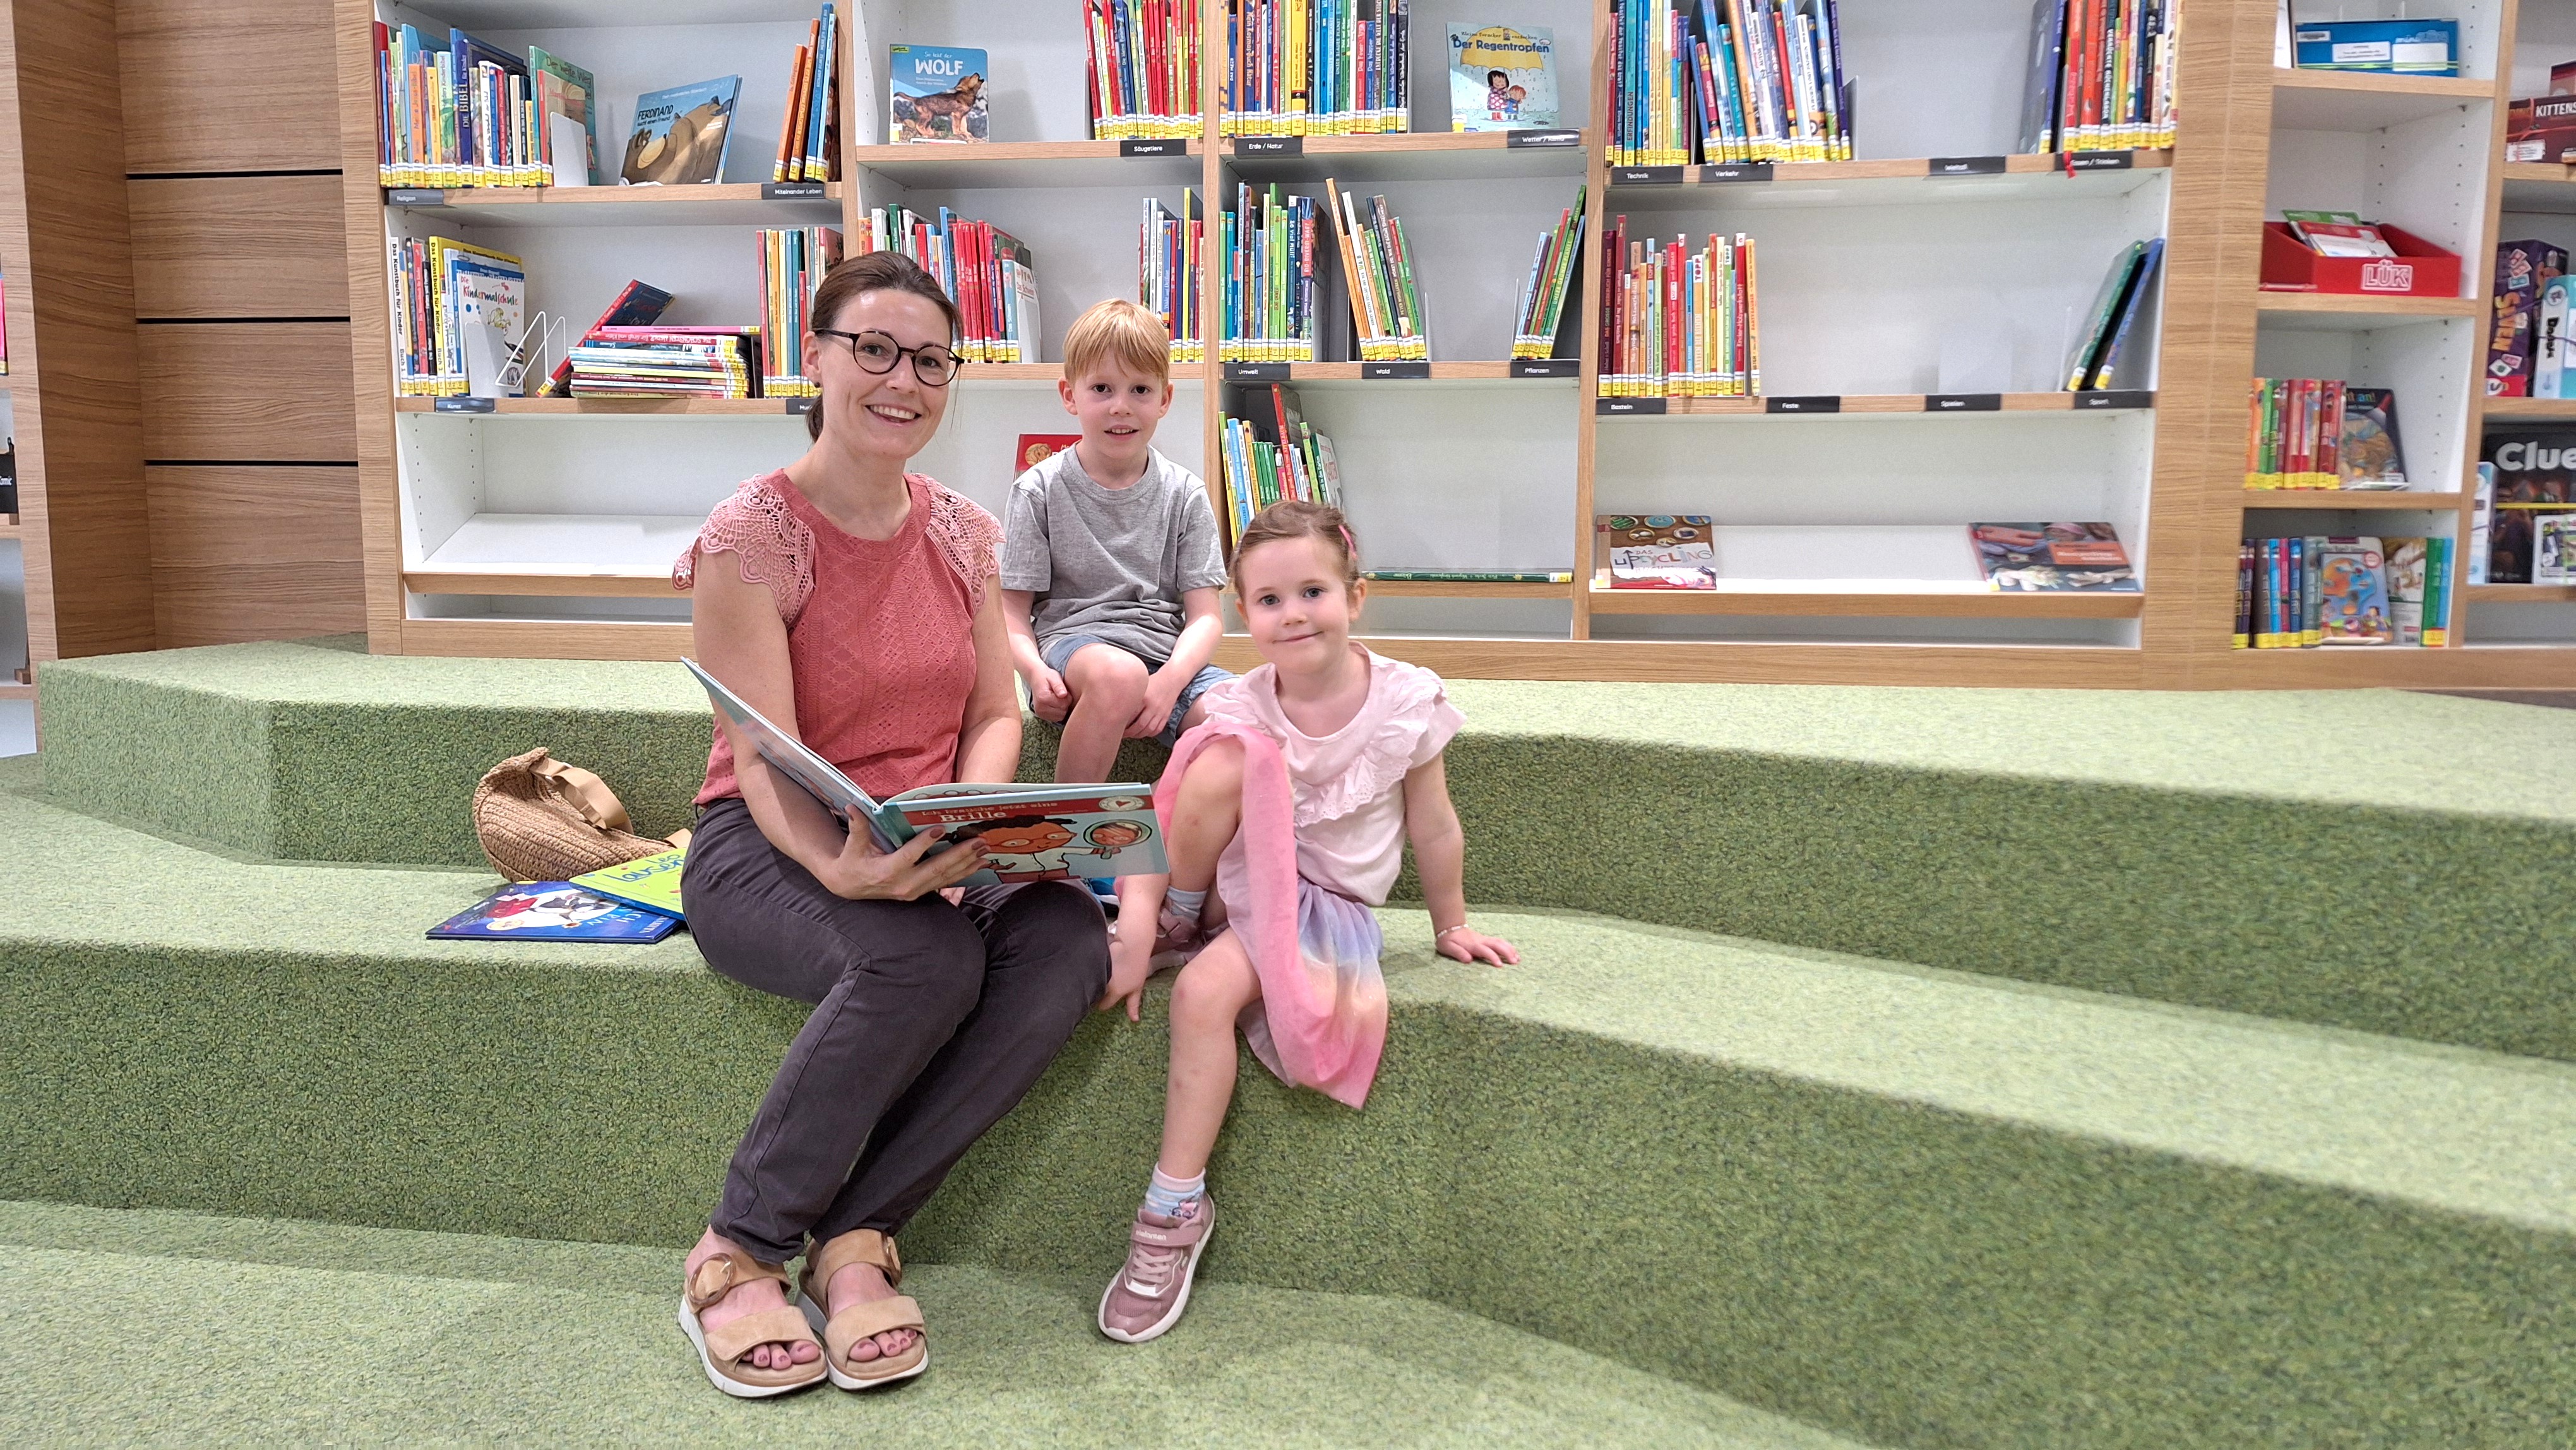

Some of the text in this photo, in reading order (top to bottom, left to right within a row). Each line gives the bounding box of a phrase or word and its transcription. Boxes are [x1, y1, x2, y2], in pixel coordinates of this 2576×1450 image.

[1453, 39, 1549, 53] Der Regentropfen
[915, 58, 963, 76] WOLF
[577, 69, 592, 87] Weg
[458, 83, 468, 112] BIBEL
[637, 104, 674, 120] FERDINAND
[2536, 102, 2576, 117] KITTENS
[1556, 263, 1566, 285] GRÜNER
[1561, 241, 1572, 261] PLANET
[461, 275, 469, 284] Die
[2365, 260, 2409, 287] LÜK
[463, 285, 518, 306] Kindermalschule
[1394, 279, 1402, 303] WOHLLEBEN
[1630, 334, 1638, 351] große
[1279, 425, 1287, 453] APFELBAUM
[2495, 441, 2576, 471] Clue
[940, 810, 1007, 822] Brille
[945, 805, 995, 815] brauche
[998, 803, 1027, 813] jetzt
[645, 854, 681, 864] Leo
